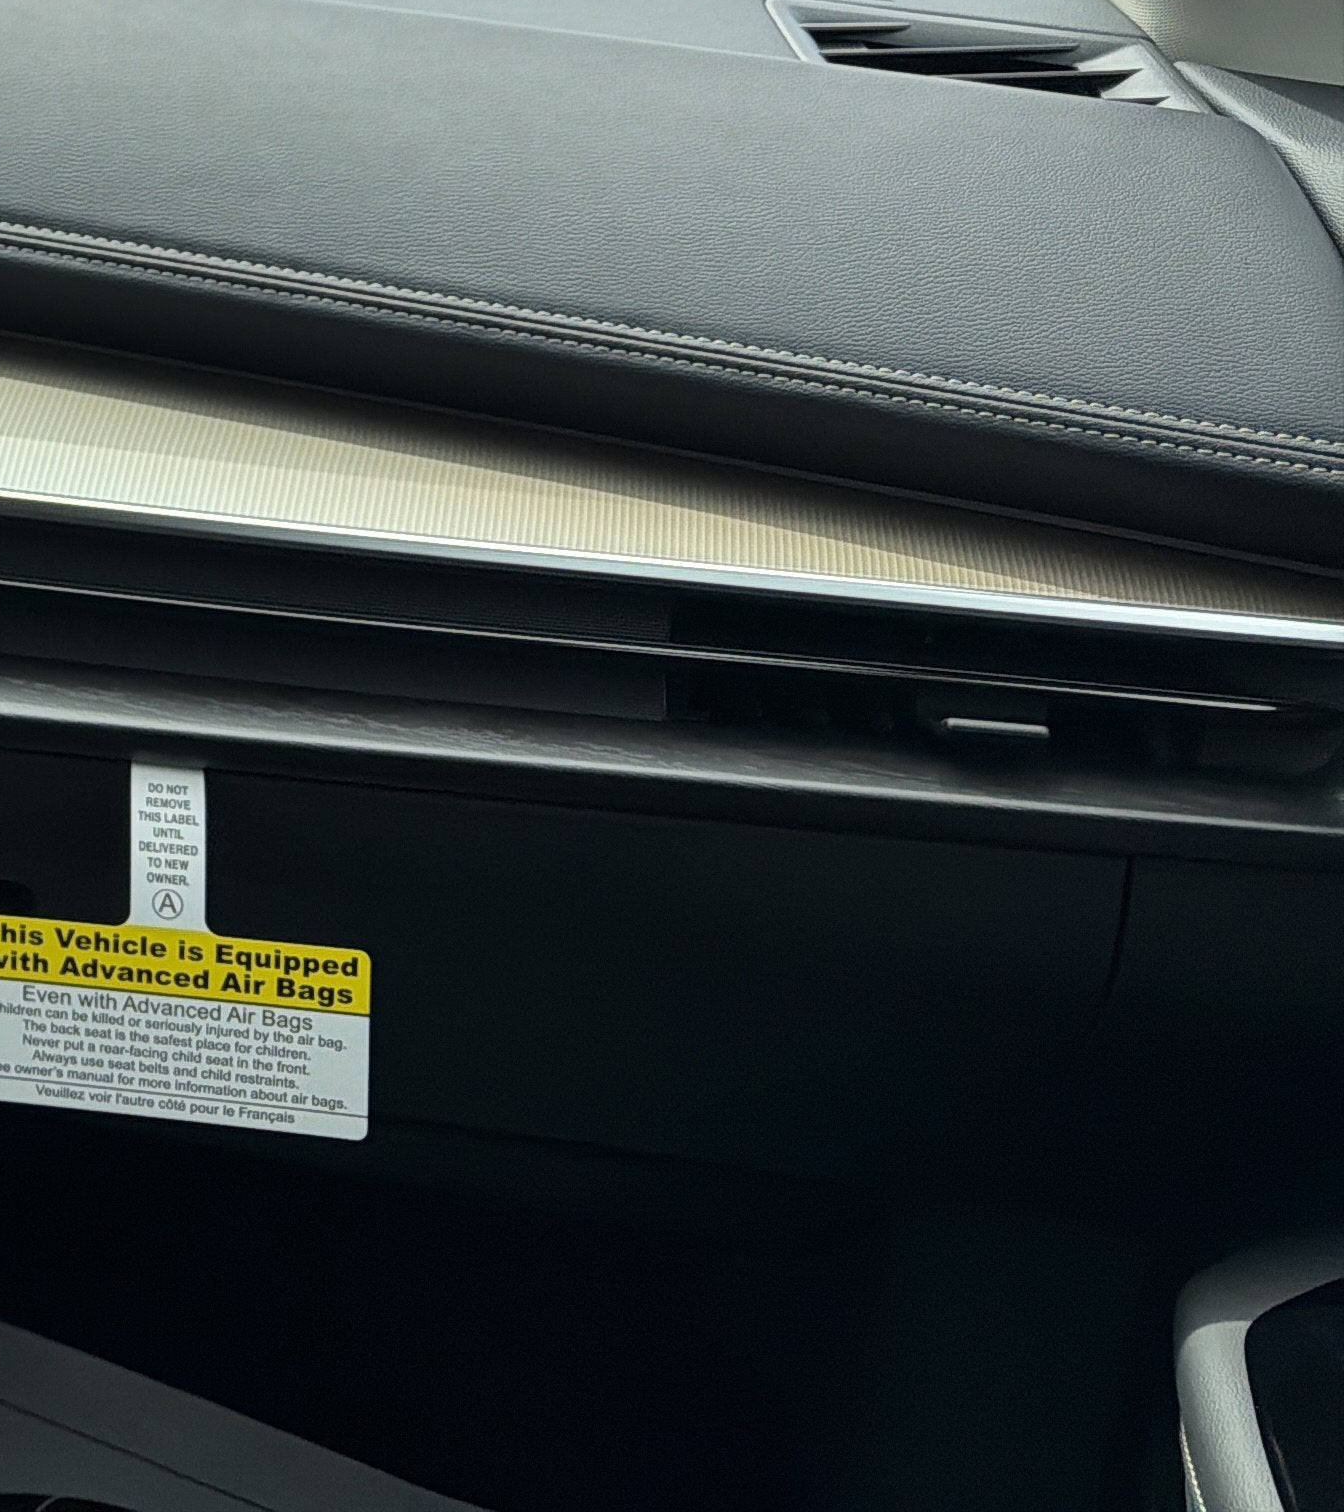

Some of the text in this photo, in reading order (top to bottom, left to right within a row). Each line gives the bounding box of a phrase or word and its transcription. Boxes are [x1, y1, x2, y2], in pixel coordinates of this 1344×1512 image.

[145, 796, 191, 810] REMOVE
[147, 782, 189, 796] DO NOT
[137, 810, 199, 827] THIS LABEL
[152, 827, 184, 840] UNTIL
[138, 840, 199, 856] DELIVERED
[146, 856, 189, 871] TO NEW
[146, 871, 190, 886] OWNER.
[158, 892, 177, 914] A
[54, 927, 167, 957] Vehicle
[178, 940, 204, 962] is
[215, 943, 359, 978] Equipped
[59, 955, 210, 989] Advanced
[220, 972, 266, 995] Air
[276, 977, 353, 1007] Bags
[22, 984, 313, 1033] Even with Advanced Air Bags
[23, 1018, 311, 1061] The back seat is the safest place for children.
[45, 1007, 69, 1020] can
[71, 1008, 89, 1022] be
[91, 1009, 125, 1026] killed
[128, 1017, 141, 1028] or
[144, 1016, 202, 1037] seriously
[205, 1023, 250, 1041] injured
[253, 1028, 269, 1043] by
[273, 1031, 294, 1044] the
[297, 1033, 315, 1046] air
[317, 1035, 348, 1052] bag.
[22, 1034, 311, 1076] Never put a rear-facing child seat in the front.
[32, 1049, 300, 1090] Always use seat belts and child restraints.
[14, 1063, 63, 1079] owner's
[66, 1069, 114, 1083] manual
[117, 1073, 135, 1087] for
[138, 1078, 172, 1090] more
[174, 1079, 247, 1099] information
[250, 1089, 288, 1103] about
[291, 1093, 309, 1106] air
[312, 1095, 348, 1111] bags.
[35, 1084, 296, 1125] Veuillez voir l'autre côté pour le Français
